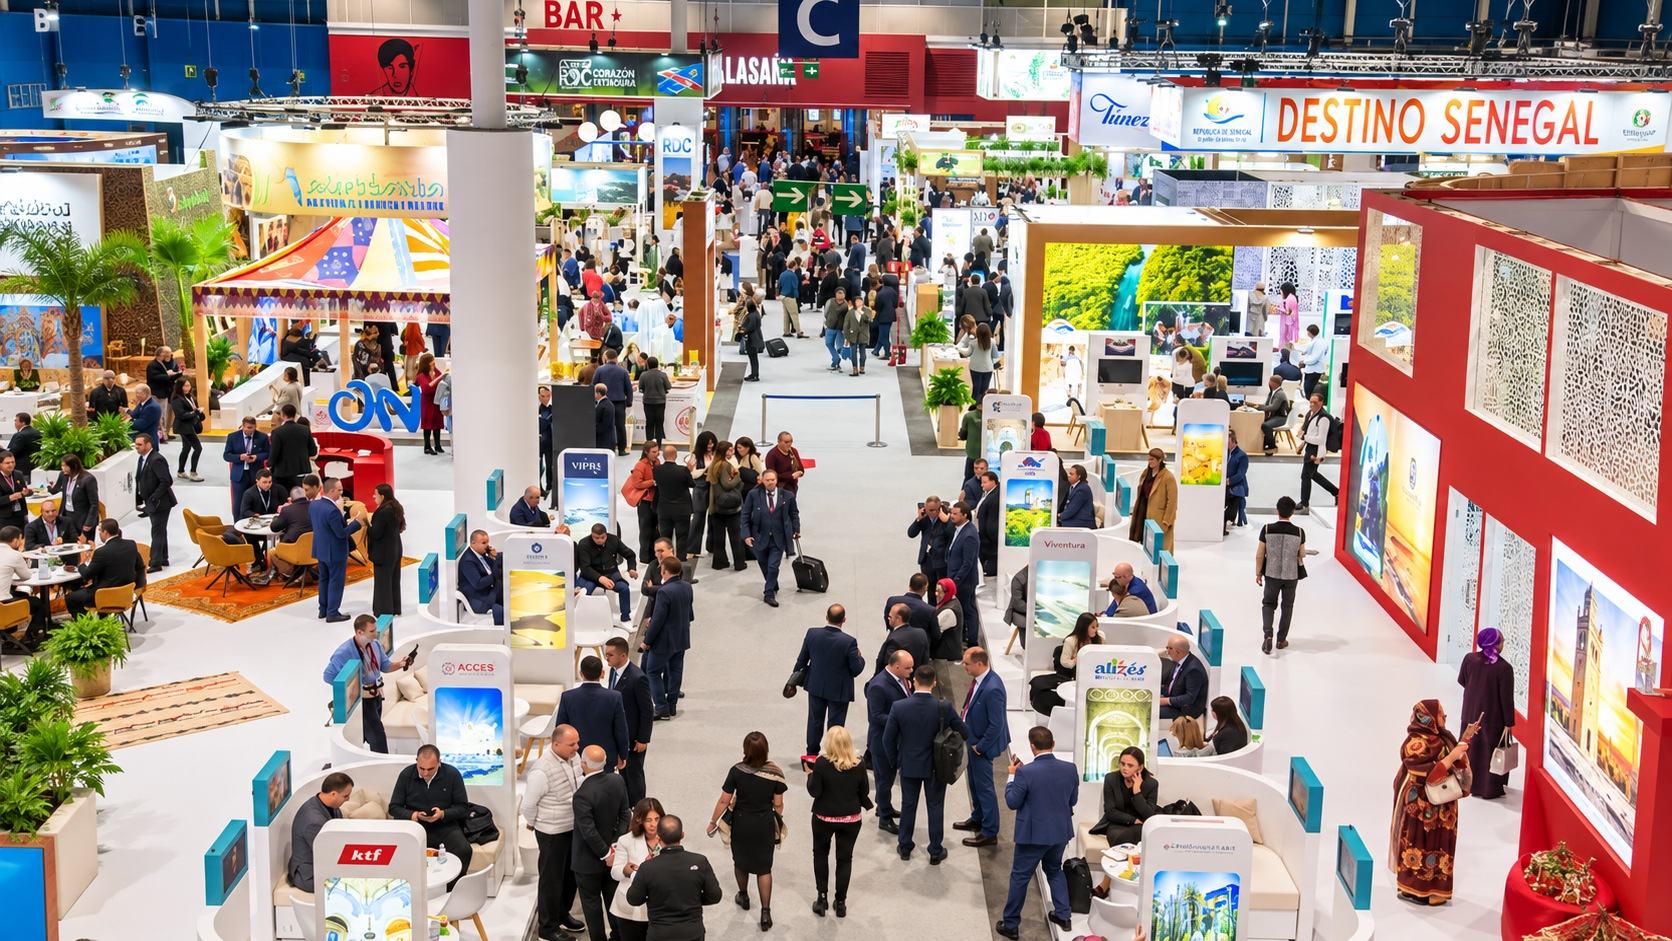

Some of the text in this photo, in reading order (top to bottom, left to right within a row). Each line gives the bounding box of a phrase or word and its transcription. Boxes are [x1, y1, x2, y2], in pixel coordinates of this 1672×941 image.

[544, 0, 604, 29] BAR
[797, 0, 840, 47] C
[593, 67, 635, 78] CORAZÓN
[1090, 93, 1150, 127] Túnez
[1277, 97, 1600, 145] DESTINO SENEGAL
[662, 137, 692, 153] RDC
[1044, 540, 1086, 549] Viventura
[457, 663, 494, 672] ACCES
[1094, 658, 1147, 676] alizés
[351, 848, 382, 861] ktf
